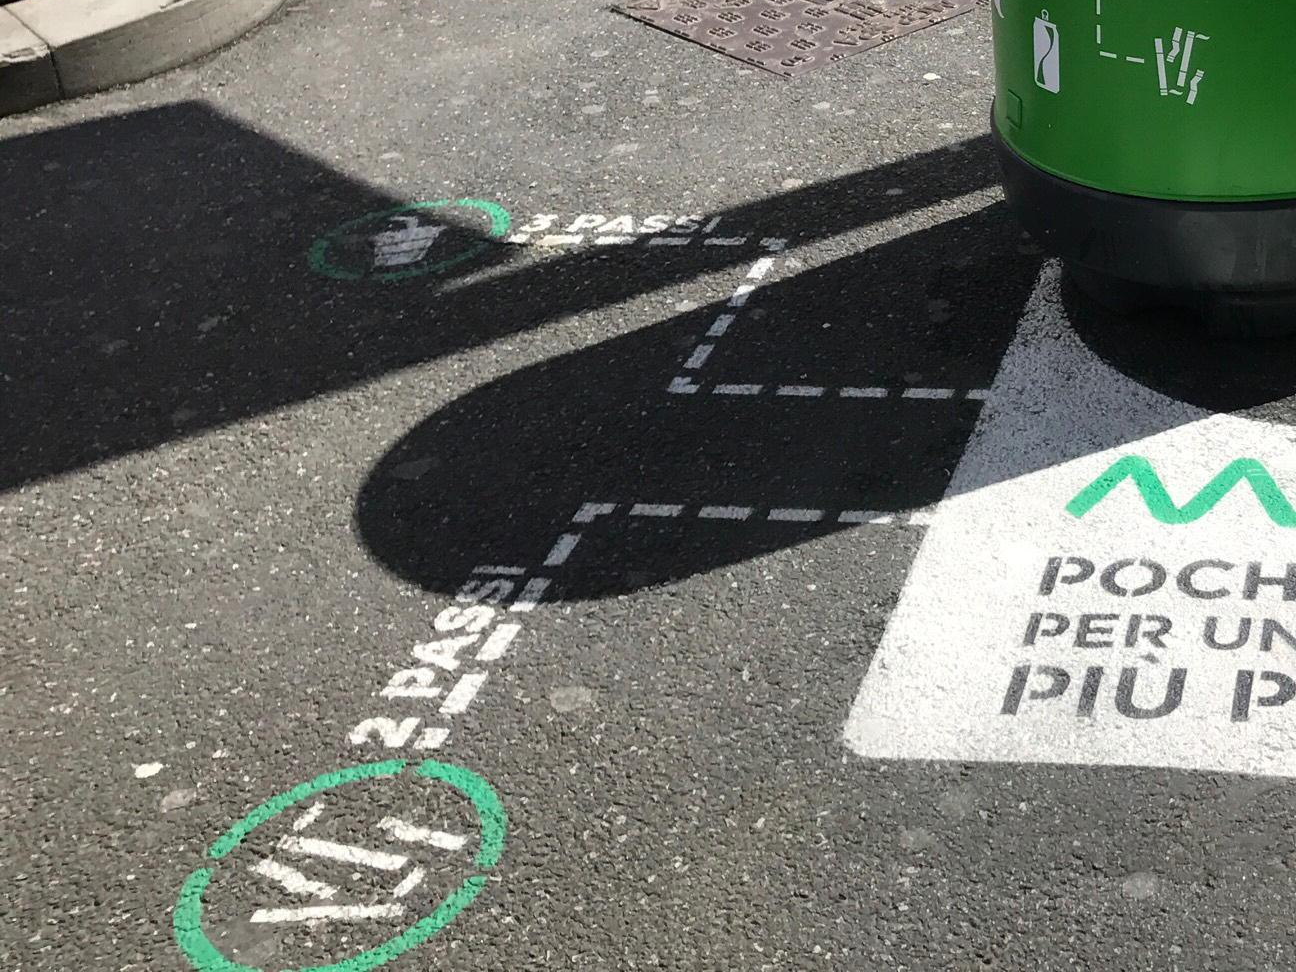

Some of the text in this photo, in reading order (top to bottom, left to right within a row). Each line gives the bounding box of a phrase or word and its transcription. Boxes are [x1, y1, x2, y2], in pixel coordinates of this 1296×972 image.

[519, 213, 723, 234] 3 PASSI
[346, 565, 527, 748] 2 PASSI
[1022, 612, 1173, 649] PER
[1000, 652, 1188, 720] PIÙ
